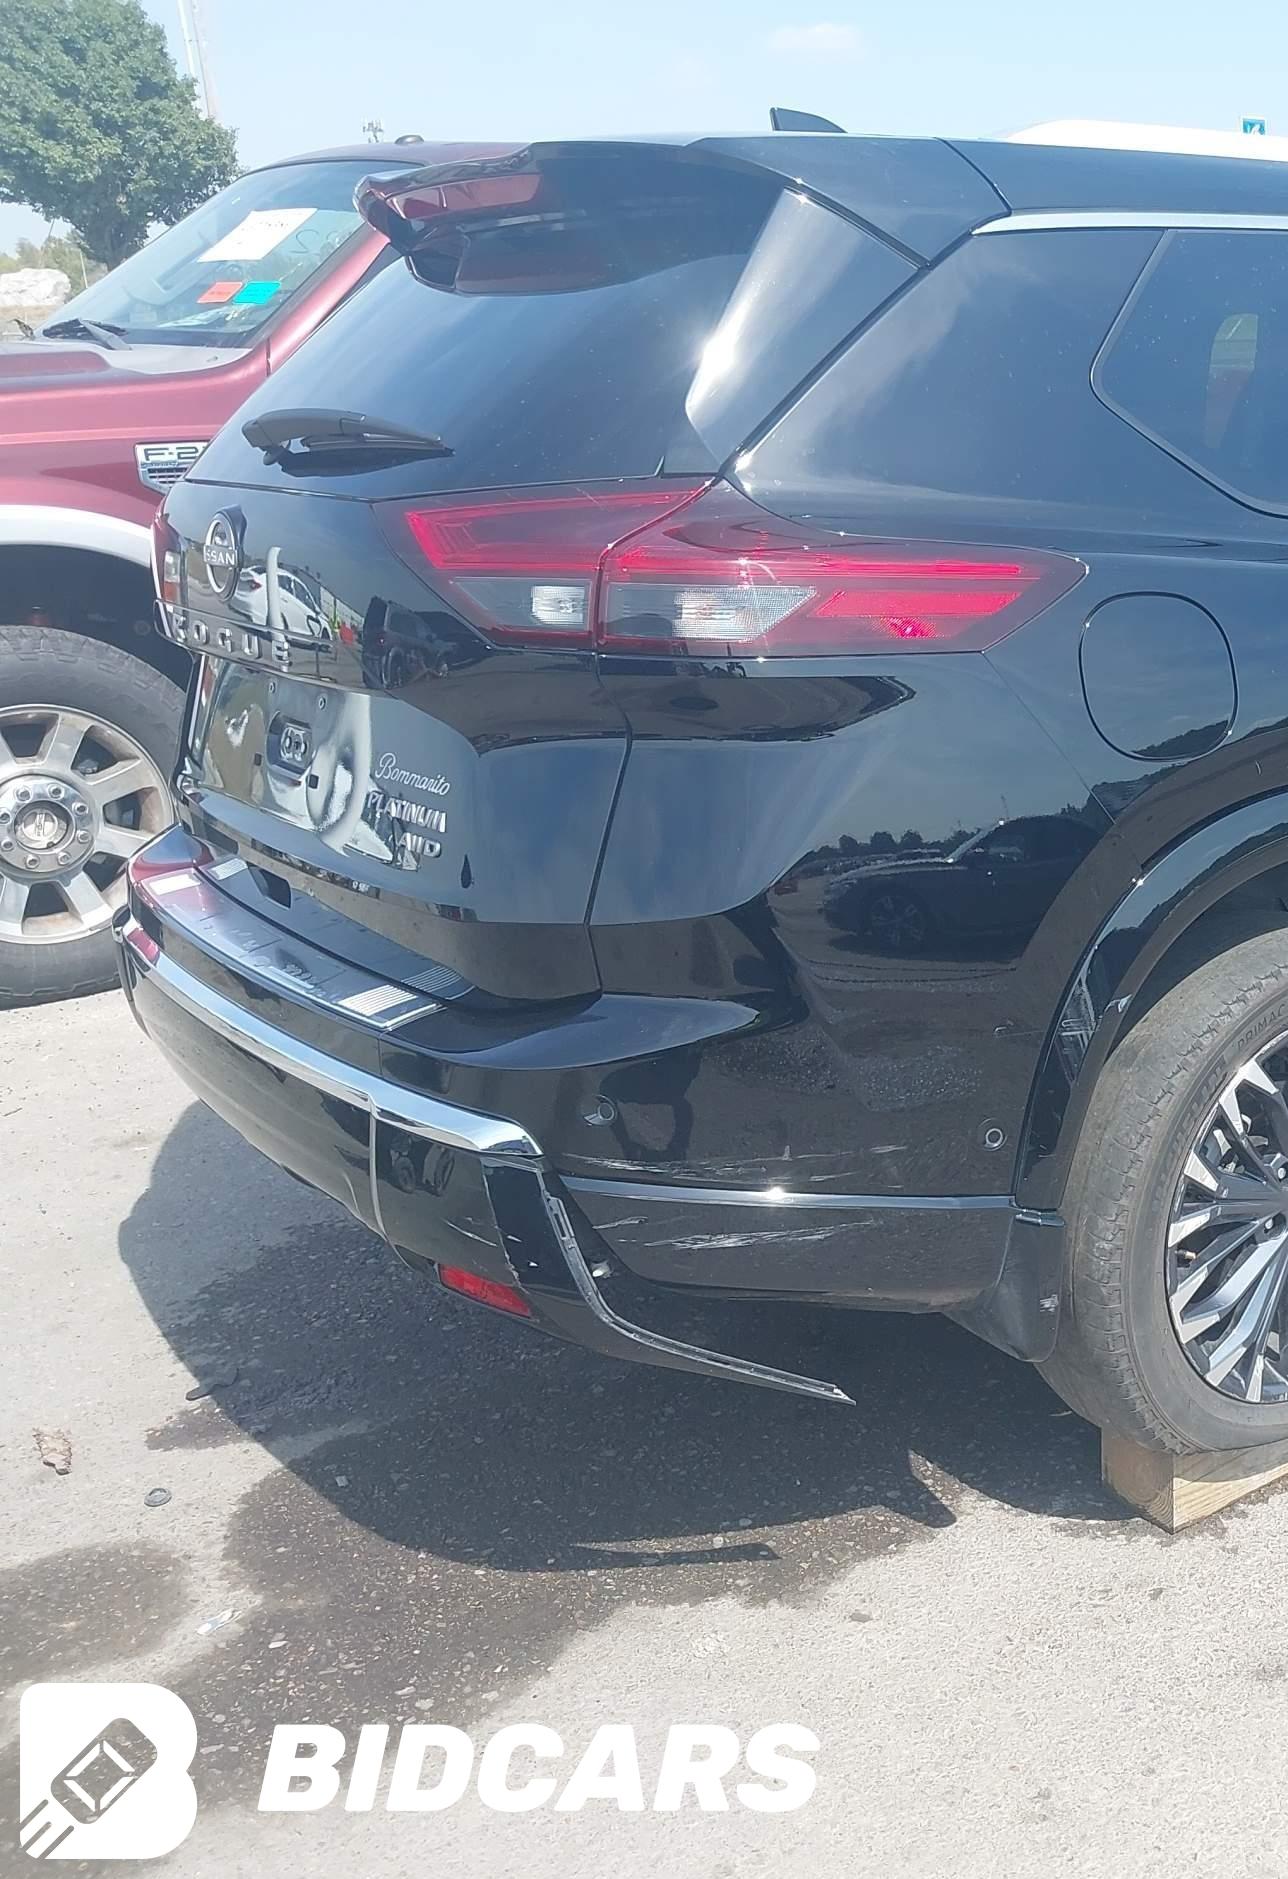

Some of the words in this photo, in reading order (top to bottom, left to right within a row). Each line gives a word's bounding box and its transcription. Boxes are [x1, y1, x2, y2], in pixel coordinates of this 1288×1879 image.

[143, 446, 205, 462] F-2
[205, 549, 235, 566] SSAN
[173, 613, 291, 665] ROGUE
[375, 752, 451, 796] Bommarito
[366, 791, 447, 833] PLATINUM
[399, 832, 442, 858] AWD
